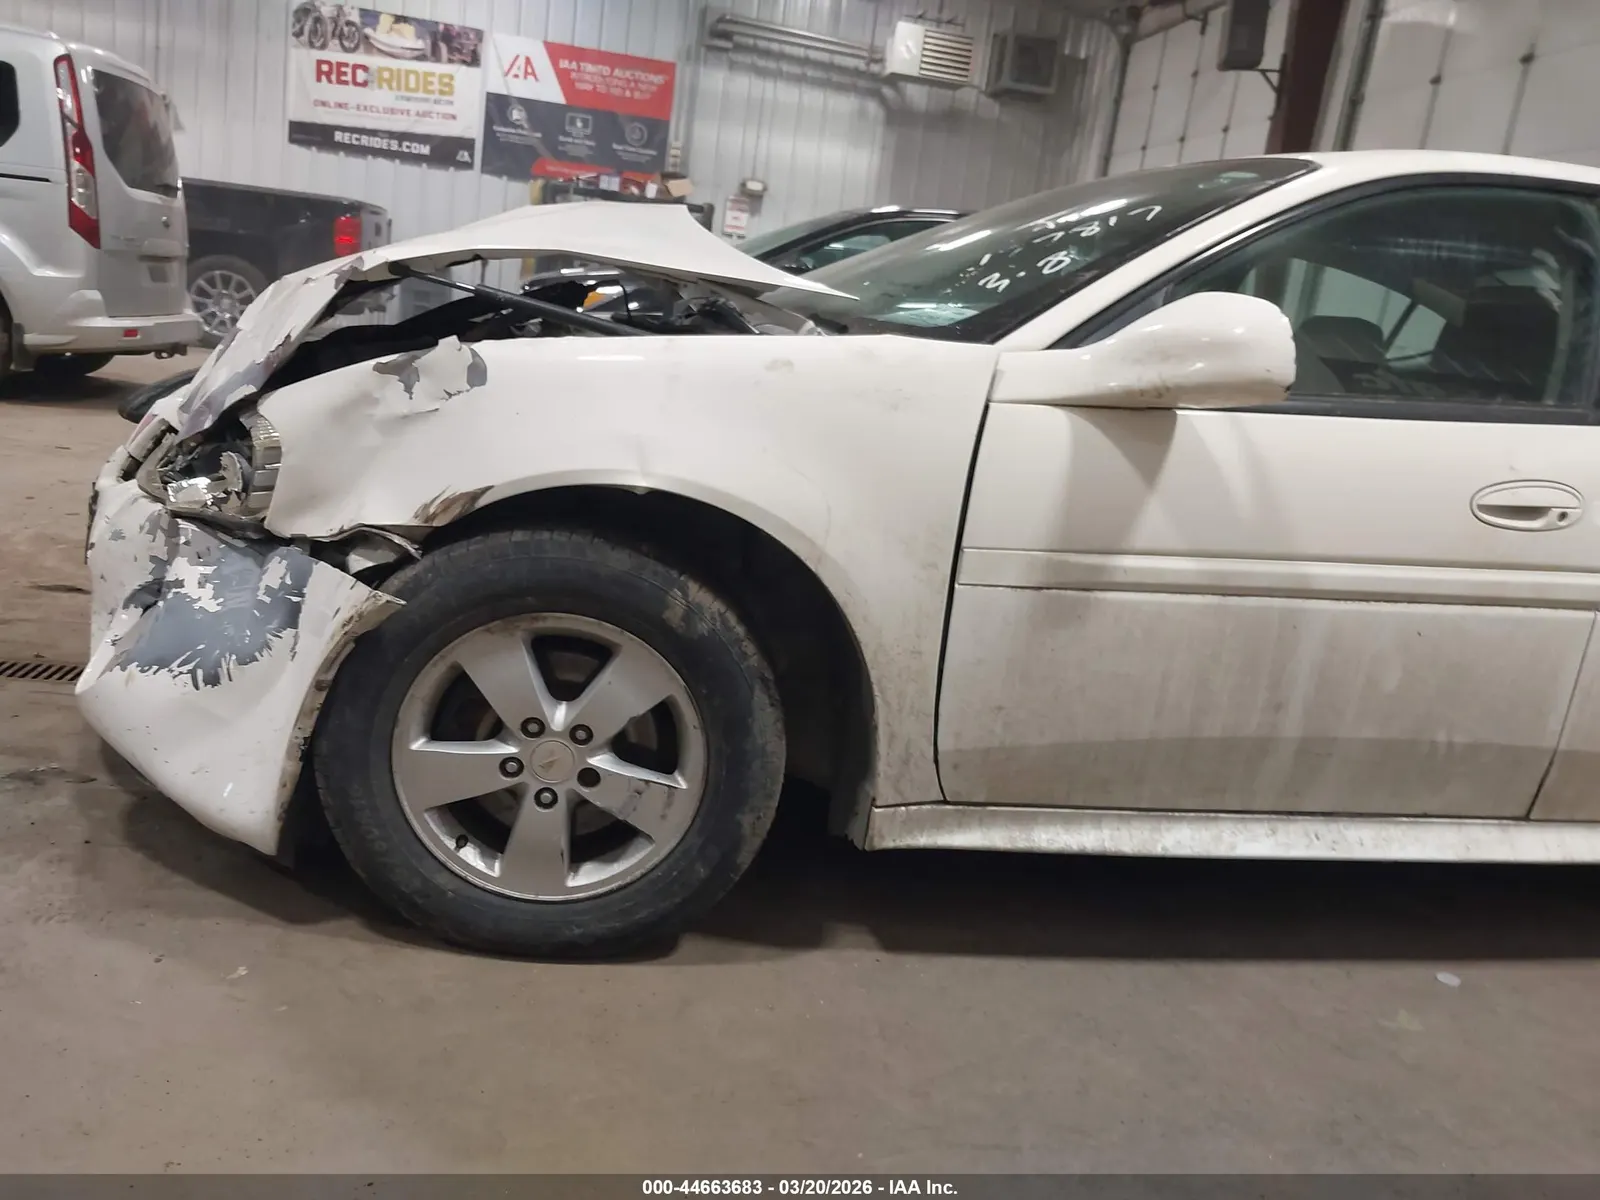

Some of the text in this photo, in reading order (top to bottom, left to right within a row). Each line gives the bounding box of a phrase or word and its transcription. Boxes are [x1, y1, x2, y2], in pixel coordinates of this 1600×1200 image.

[315, 59, 455, 96] REC RIDES
[415, 108, 458, 121] AUCTION
[333, 130, 431, 156] RECRIDES.COM
